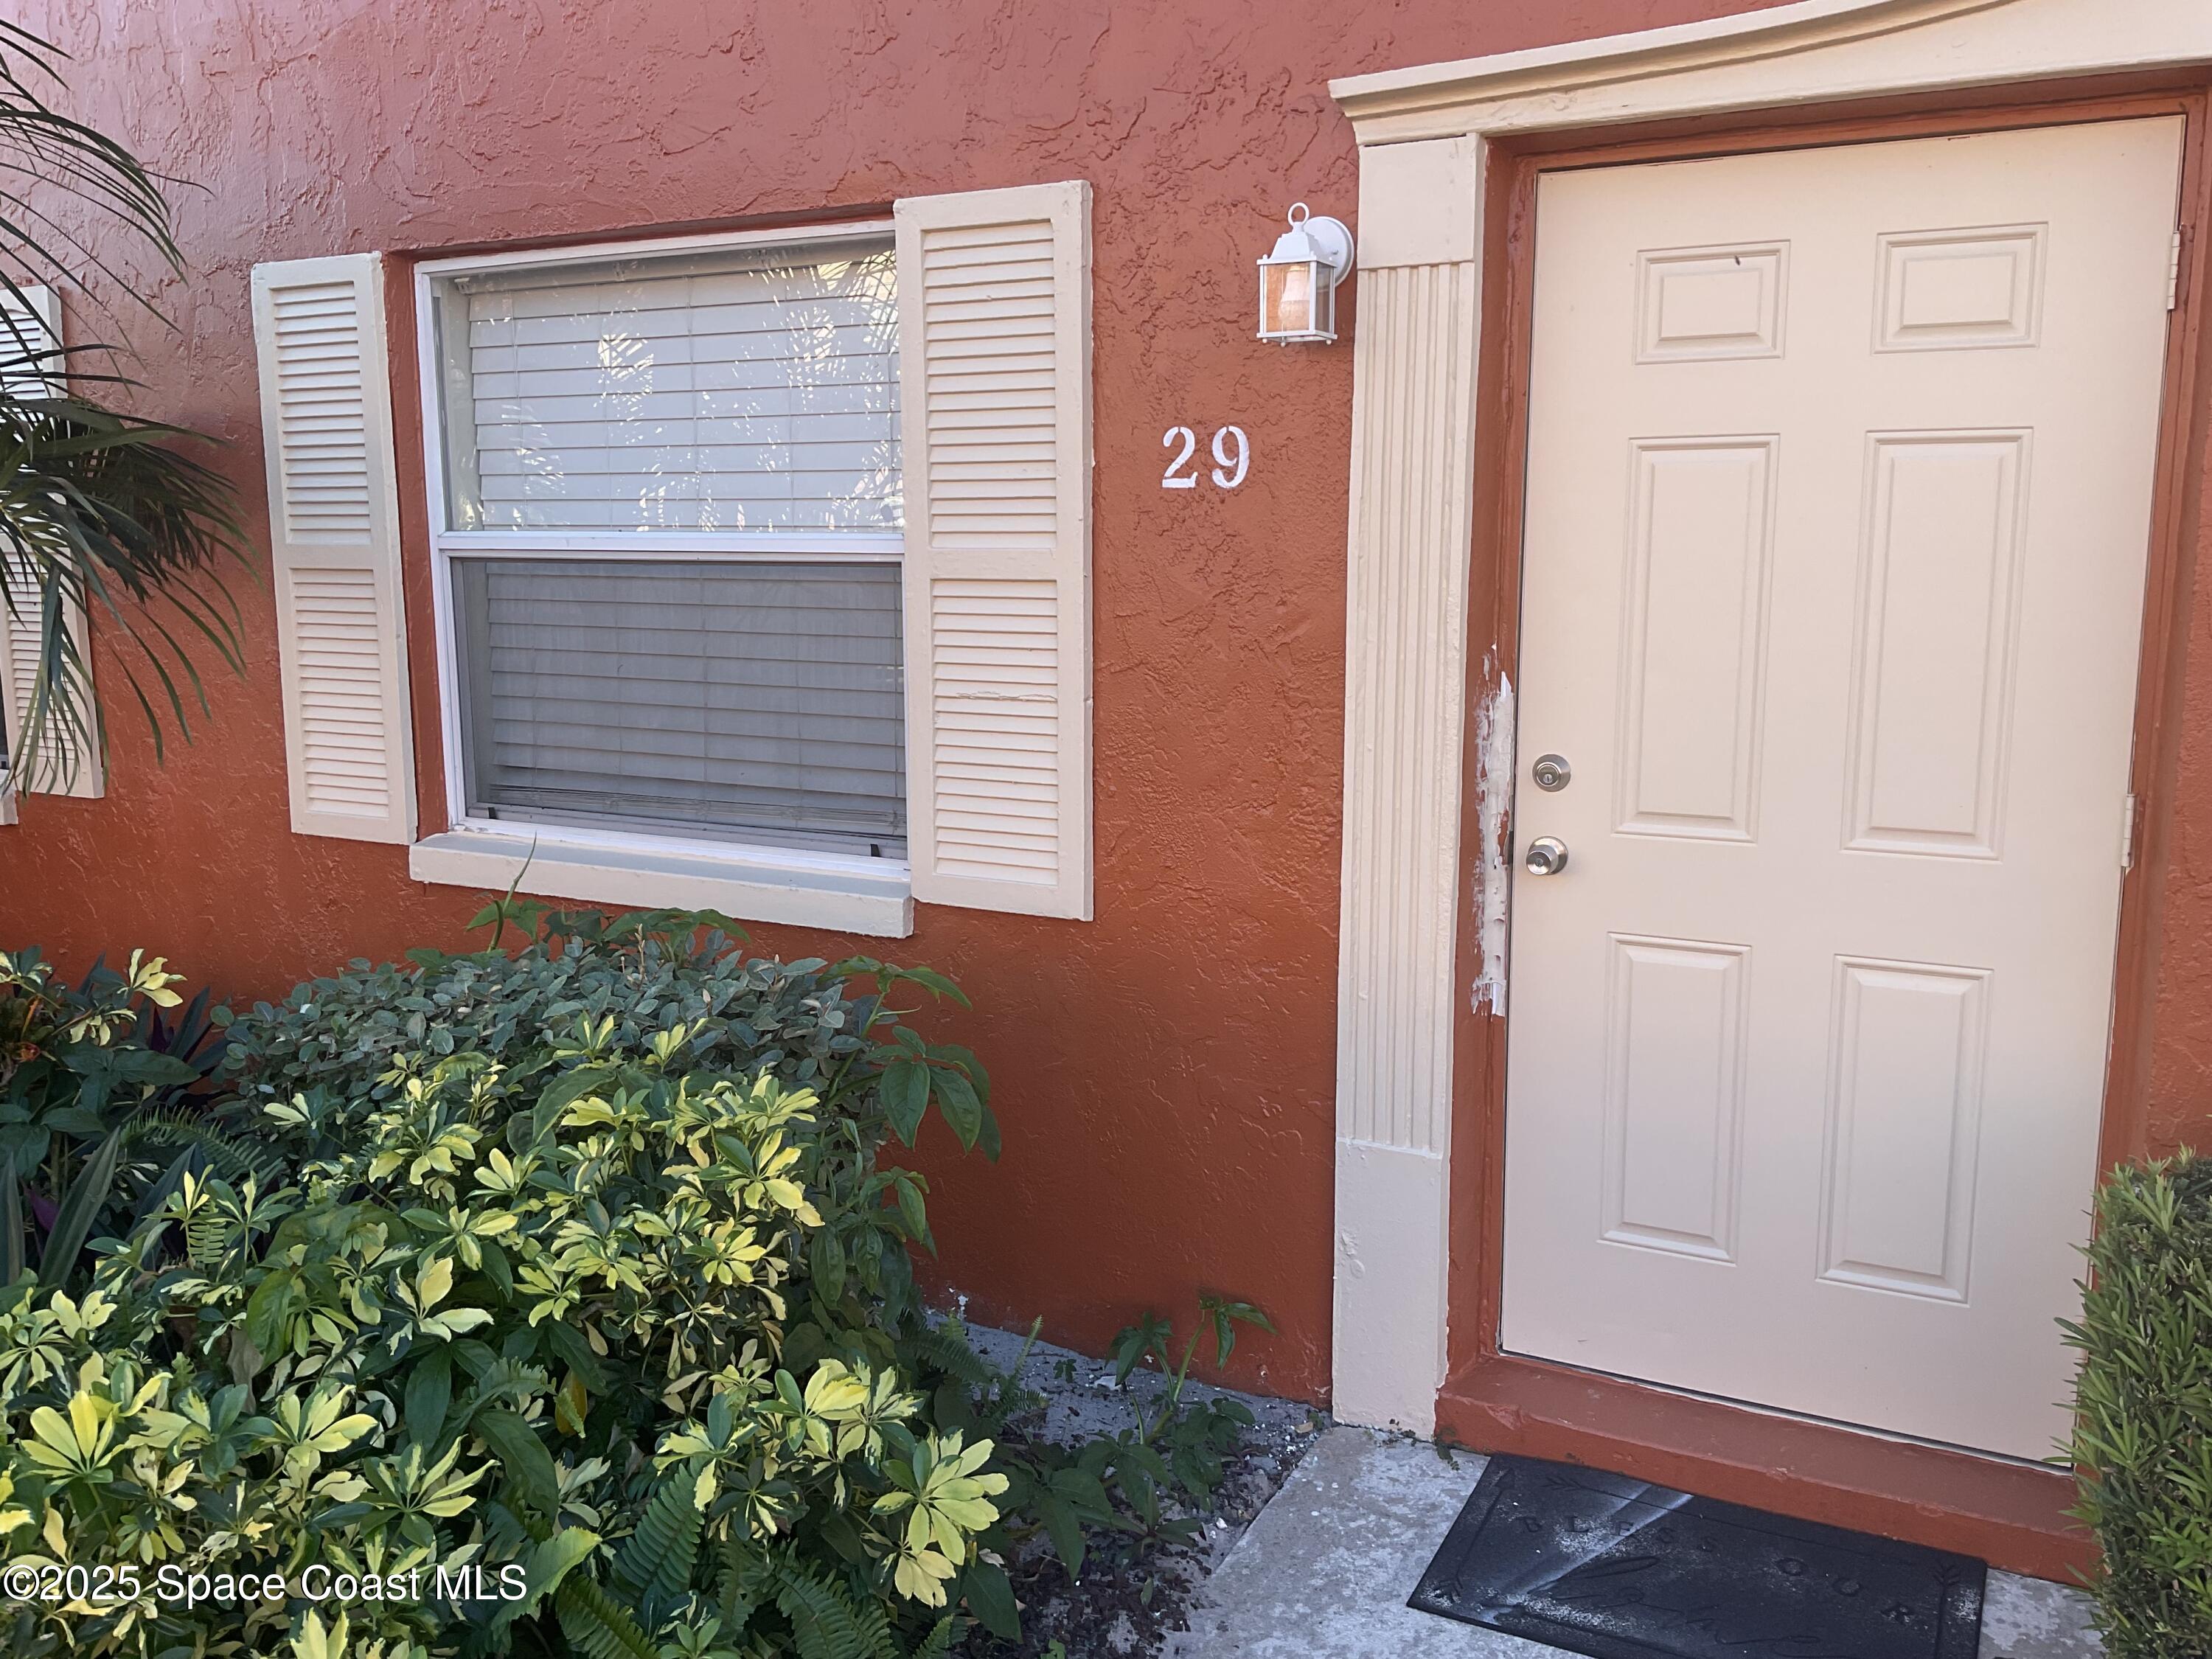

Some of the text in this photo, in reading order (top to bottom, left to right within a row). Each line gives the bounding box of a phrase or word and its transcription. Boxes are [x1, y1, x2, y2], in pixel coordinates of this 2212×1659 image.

[1161, 425, 1251, 489] 29
[1517, 1515, 1916, 1624] BLESS OUR
